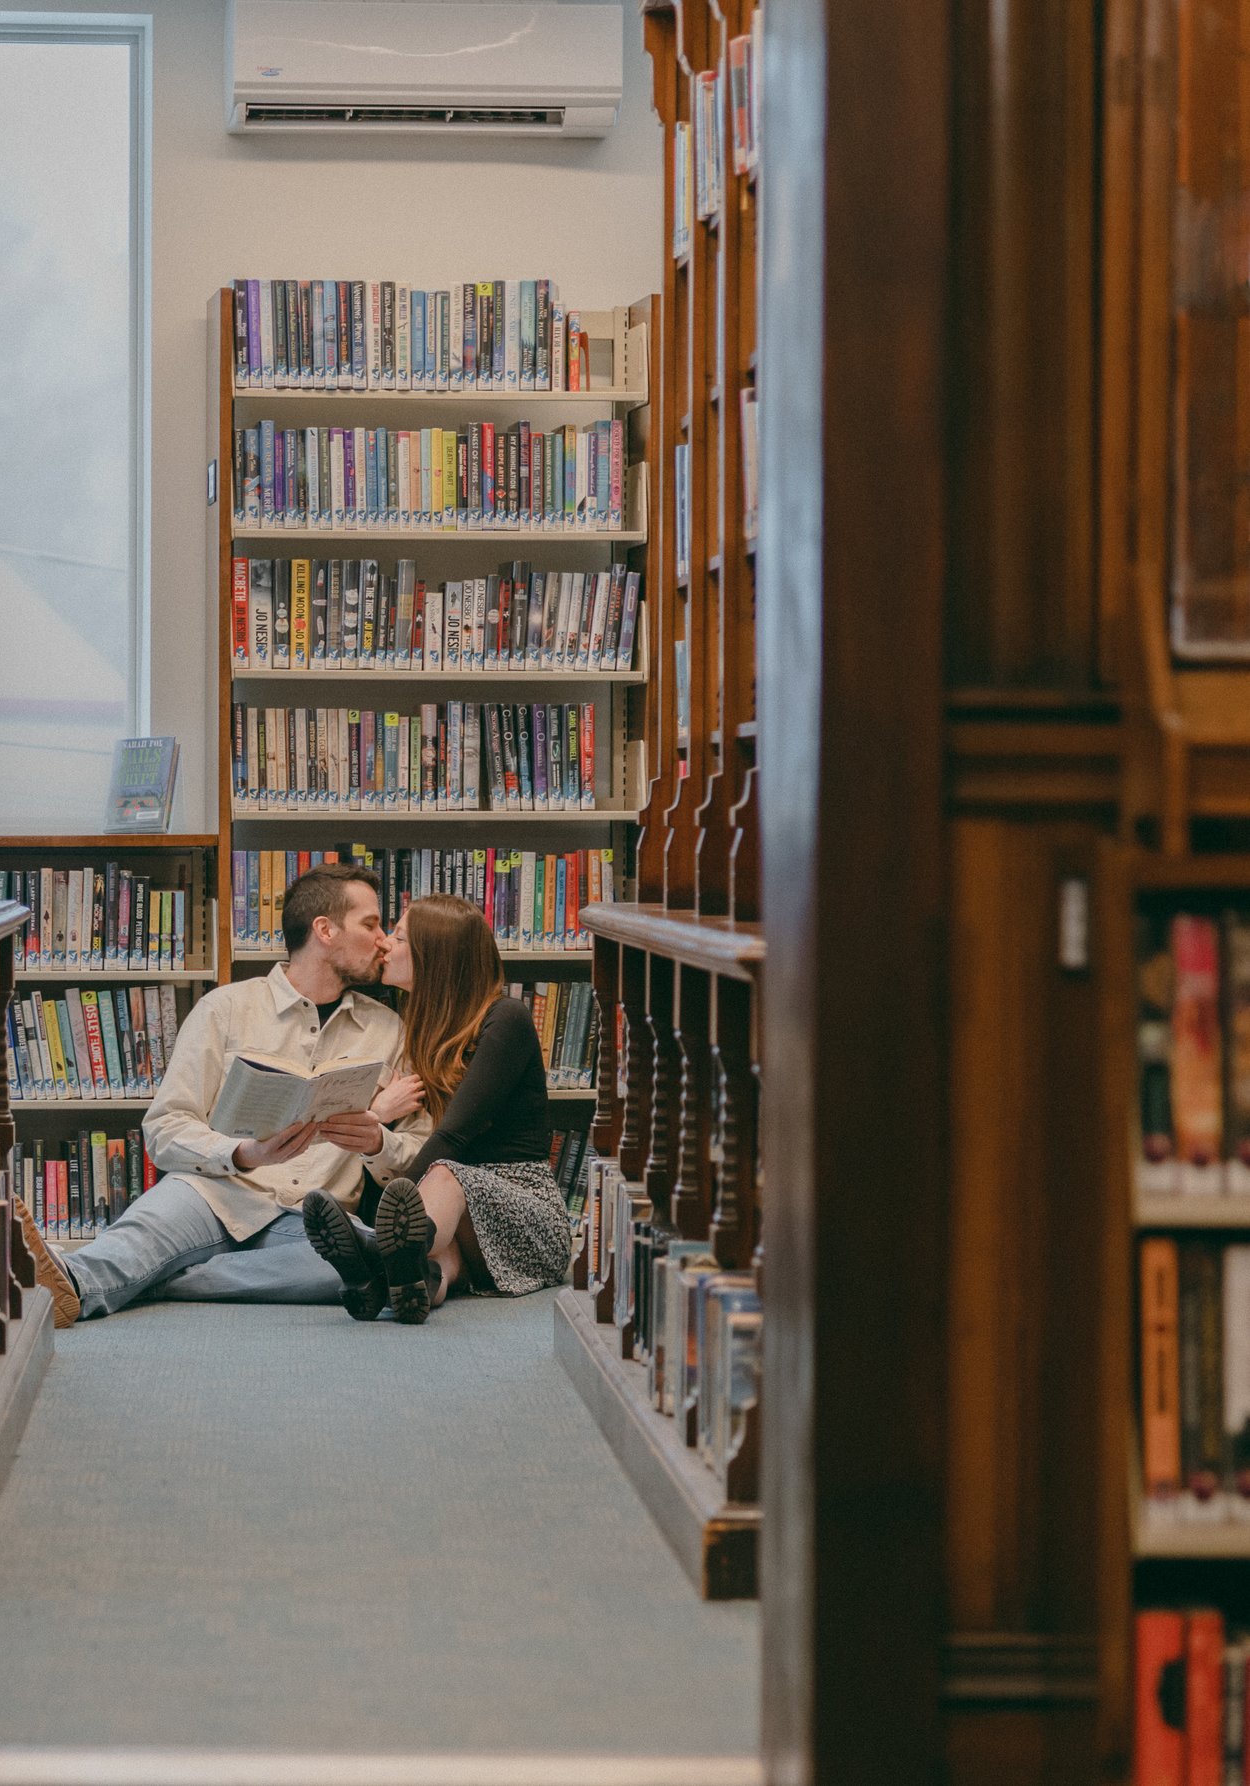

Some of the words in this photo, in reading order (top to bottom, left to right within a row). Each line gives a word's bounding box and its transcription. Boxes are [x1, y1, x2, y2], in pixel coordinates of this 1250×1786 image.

[354, 284, 363, 319] VANISHING
[464, 287, 474, 312] MARCIA
[354, 322, 363, 344] POINT
[510, 436, 516, 445] MY
[472, 450, 479, 460] OF
[234, 562, 246, 602] MACBETH
[296, 564, 306, 594] KILLING
[464, 583, 472, 594] JO
[476, 581, 485, 592] JO
[366, 587, 375, 599] THE
[256, 608, 268, 621] JO
[296, 596, 306, 619] MOON
[365, 600, 375, 620] THIRST
[464, 594, 472, 620] NESBO
[476, 594, 485, 618] NESBO
[364, 622, 373, 630] JO
[448, 616, 460, 628] JO
[297, 630, 306, 639] JO
[490, 710, 498, 731] Stone
[518, 706, 527, 730] CAROL
[536, 710, 545, 733] CAROL
[568, 710, 577, 729] CAROL
[584, 705, 593, 722] Carol
[492, 732, 500, 753] Angel
[569, 730, 577, 761] O'CONNELL
[494, 756, 502, 772] Carol
[136, 884, 144, 902] IMPURE
[522, 864, 533, 925] QUOTIENTS
[14, 1004, 23, 1024] MONET
[85, 1005, 99, 1037] OSLEY
[16, 1026, 26, 1054] MURDERS
[551, 1135, 564, 1153] SARA
[570, 1140, 581, 1155] SARA
[70, 1160, 78, 1172] LIFE
[562, 1155, 578, 1183] PARETSKY
[71, 1185, 79, 1198] LIFE
